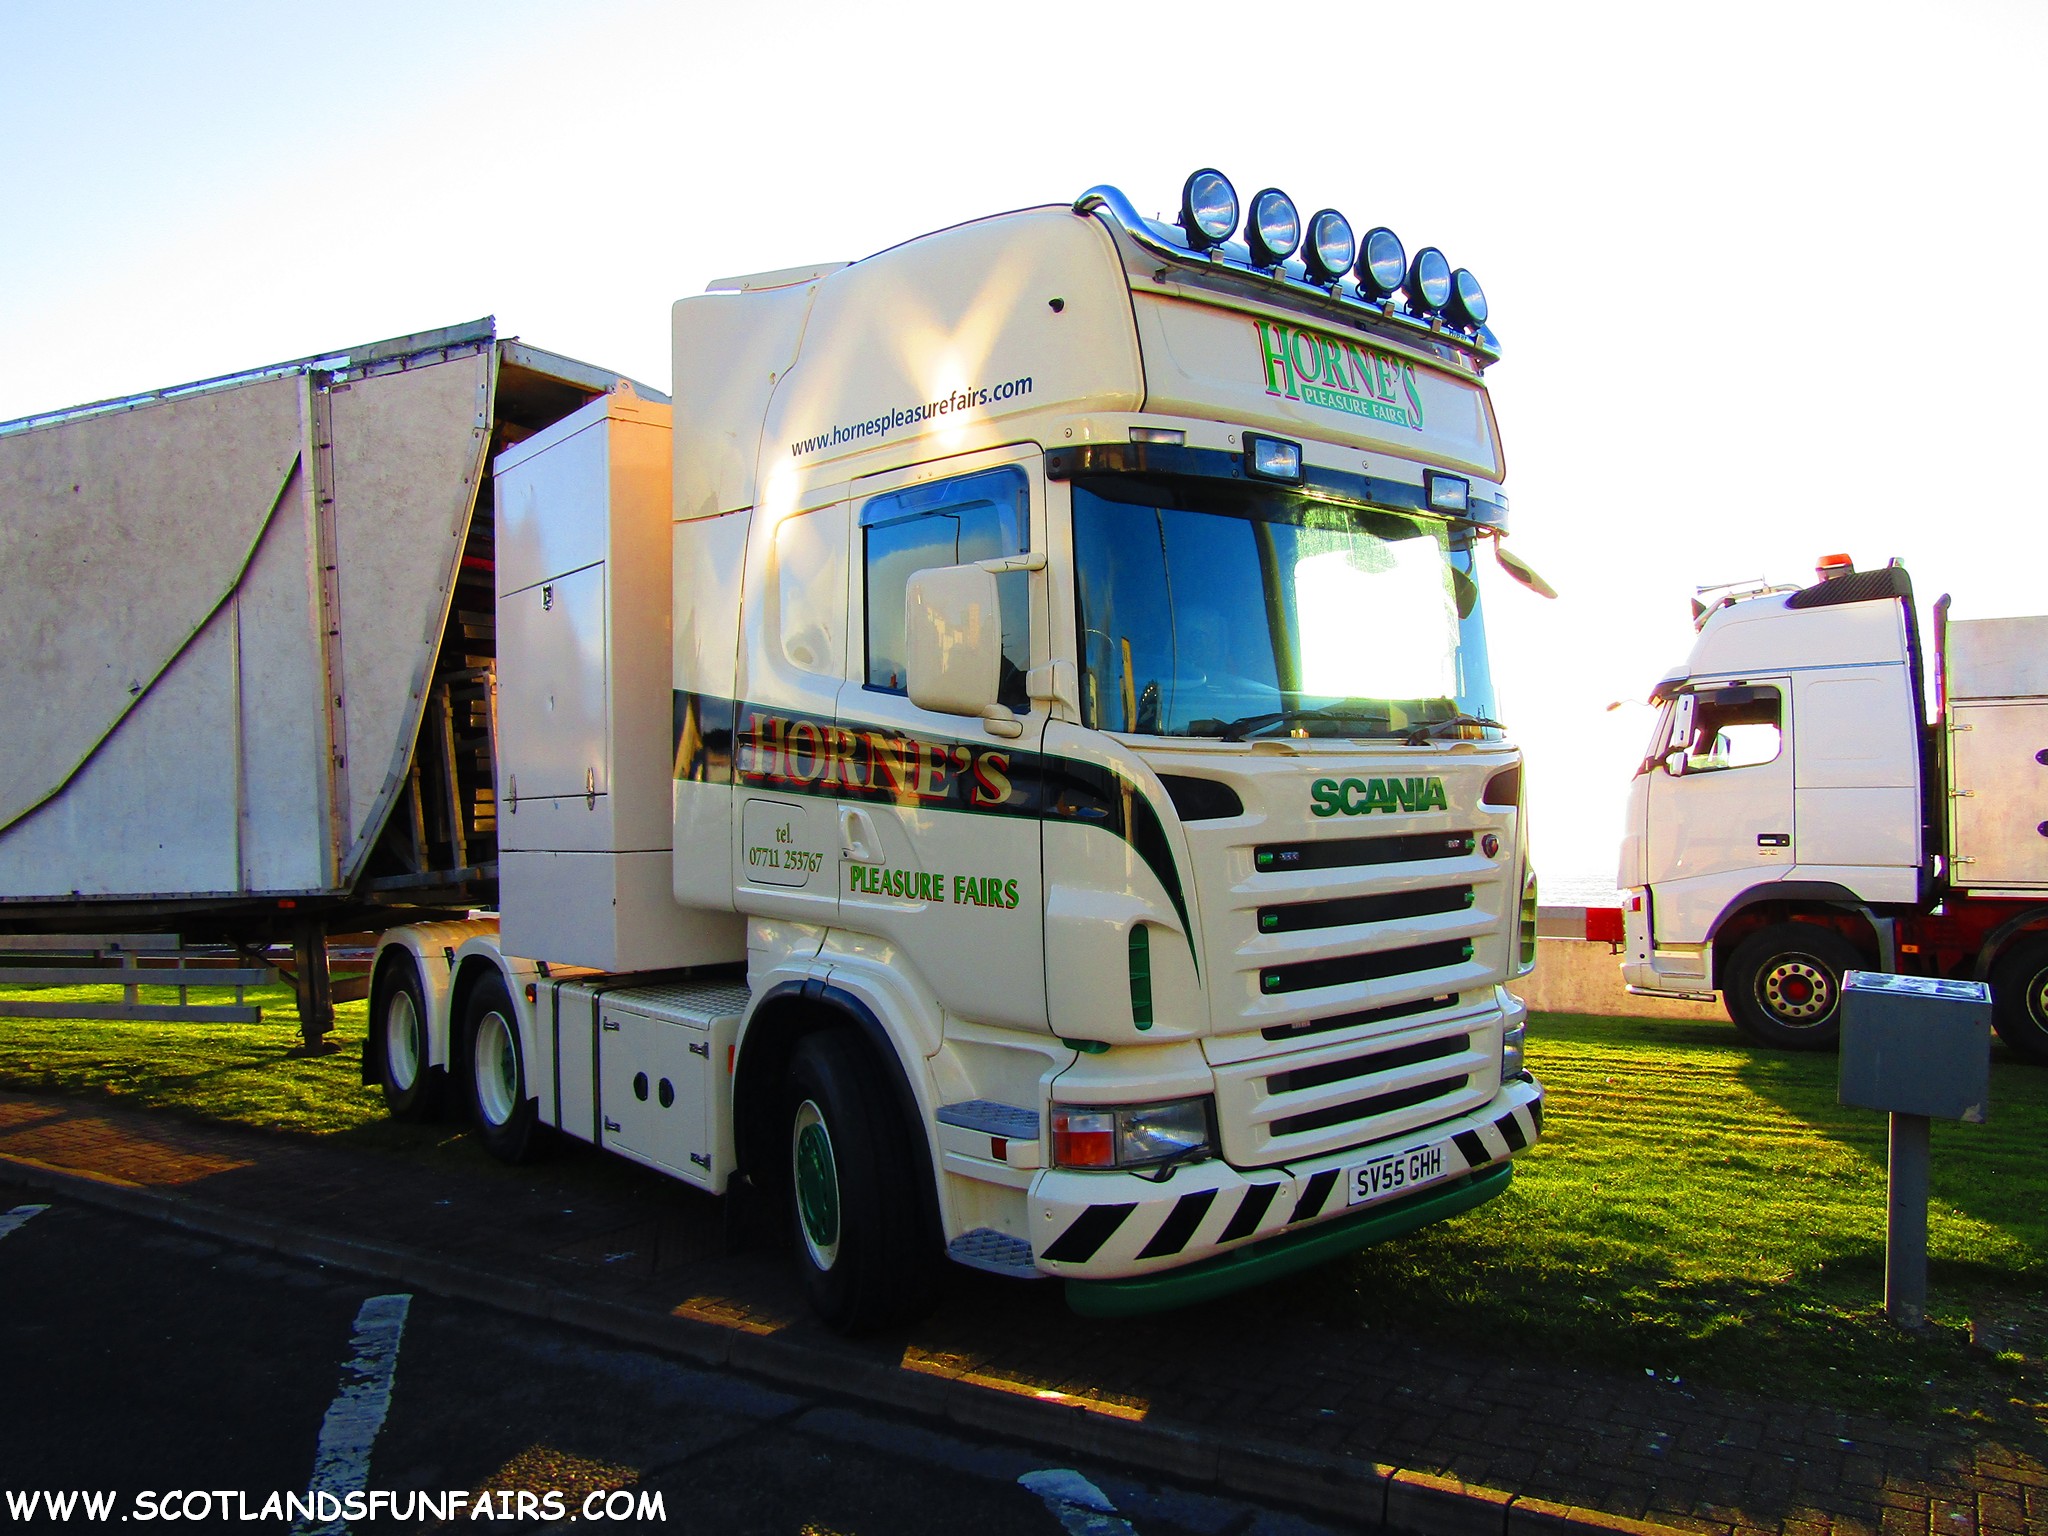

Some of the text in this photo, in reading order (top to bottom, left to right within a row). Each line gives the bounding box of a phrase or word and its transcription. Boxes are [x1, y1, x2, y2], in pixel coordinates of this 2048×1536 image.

[1253, 319, 1424, 432] HORNE'S
[791, 375, 1034, 457] www.hornespleasurefairs.com
[1304, 387, 1406, 425] PLEASURE FAIRS
[745, 712, 1013, 808] HORNE'S
[1310, 776, 1448, 817] SCANIA
[775, 822, 794, 844] tel.
[749, 846, 824, 873] 07711 253767
[850, 865, 1020, 910] PLEASURE FAIRS
[1357, 1147, 1441, 1197] SV55 GHH
